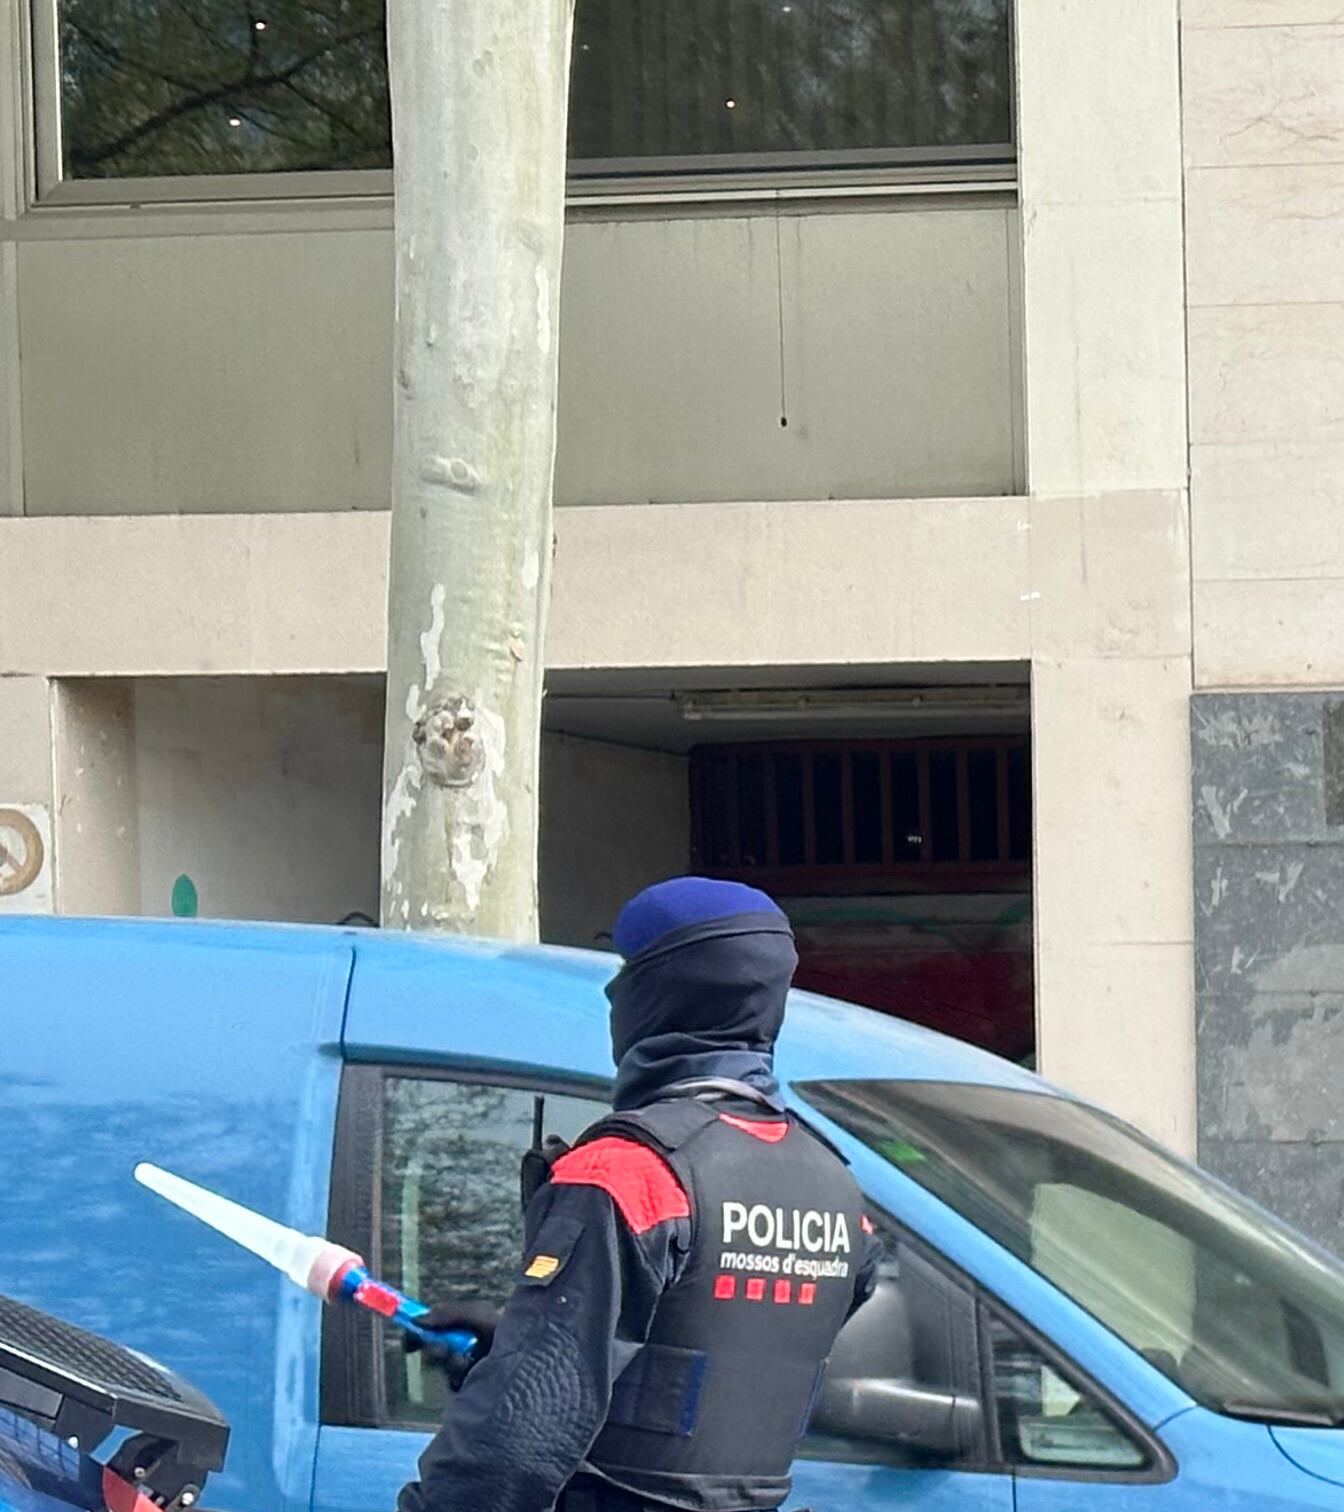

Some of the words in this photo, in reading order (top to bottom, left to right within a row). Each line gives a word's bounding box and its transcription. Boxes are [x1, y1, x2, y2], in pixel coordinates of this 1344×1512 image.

[722, 1202, 850, 1253] POLICIA
[720, 1252, 780, 1273] mossos
[782, 1254, 849, 1280] d'esquadra
